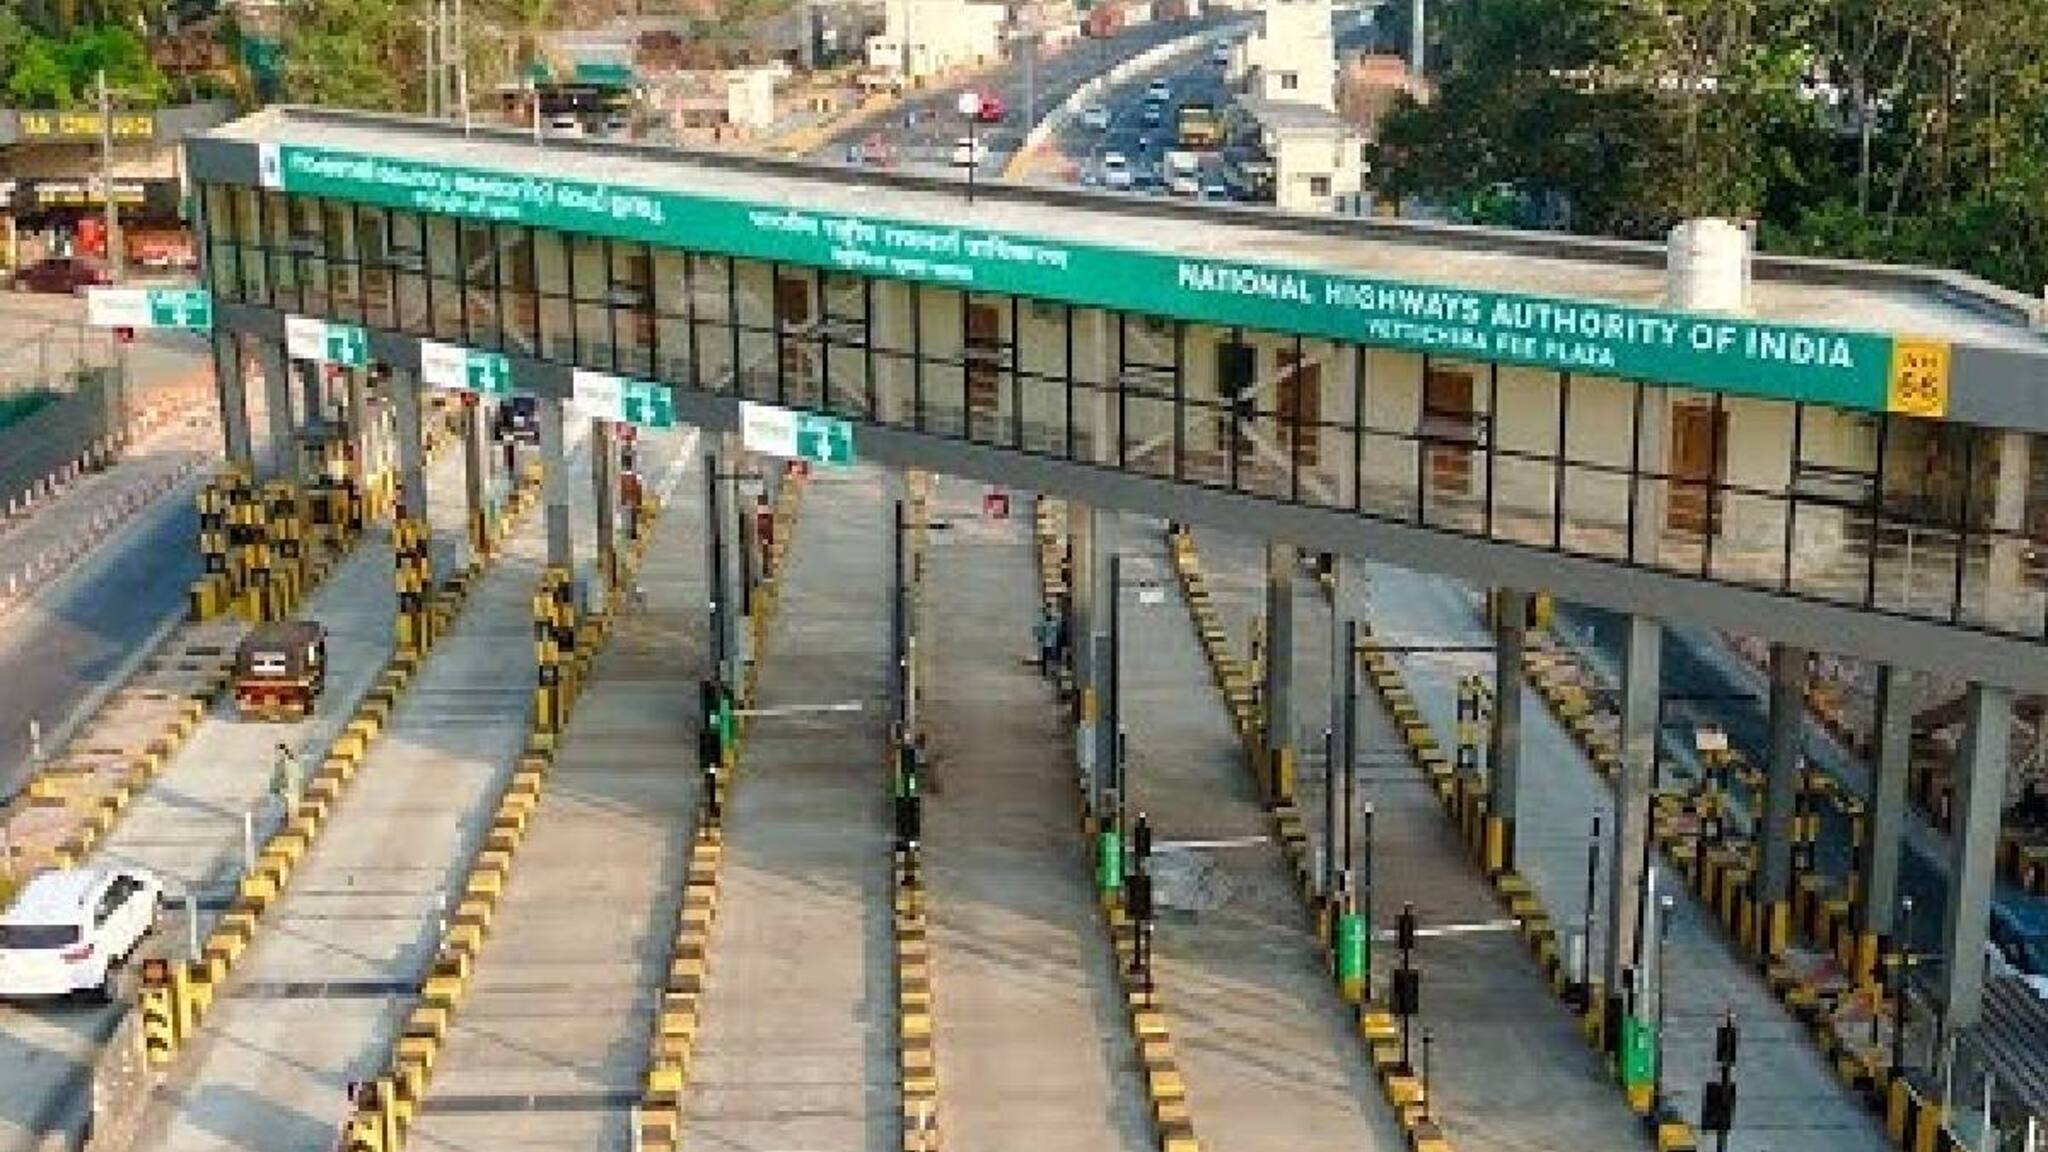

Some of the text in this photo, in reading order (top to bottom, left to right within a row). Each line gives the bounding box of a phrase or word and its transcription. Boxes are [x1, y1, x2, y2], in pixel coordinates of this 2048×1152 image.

[1178, 261, 1853, 368] NATIONAL HIGHWAYS AUTHORITY OF INDIA
[1496, 331, 1537, 359] FEE
[1545, 336, 1616, 367] PLAZA
